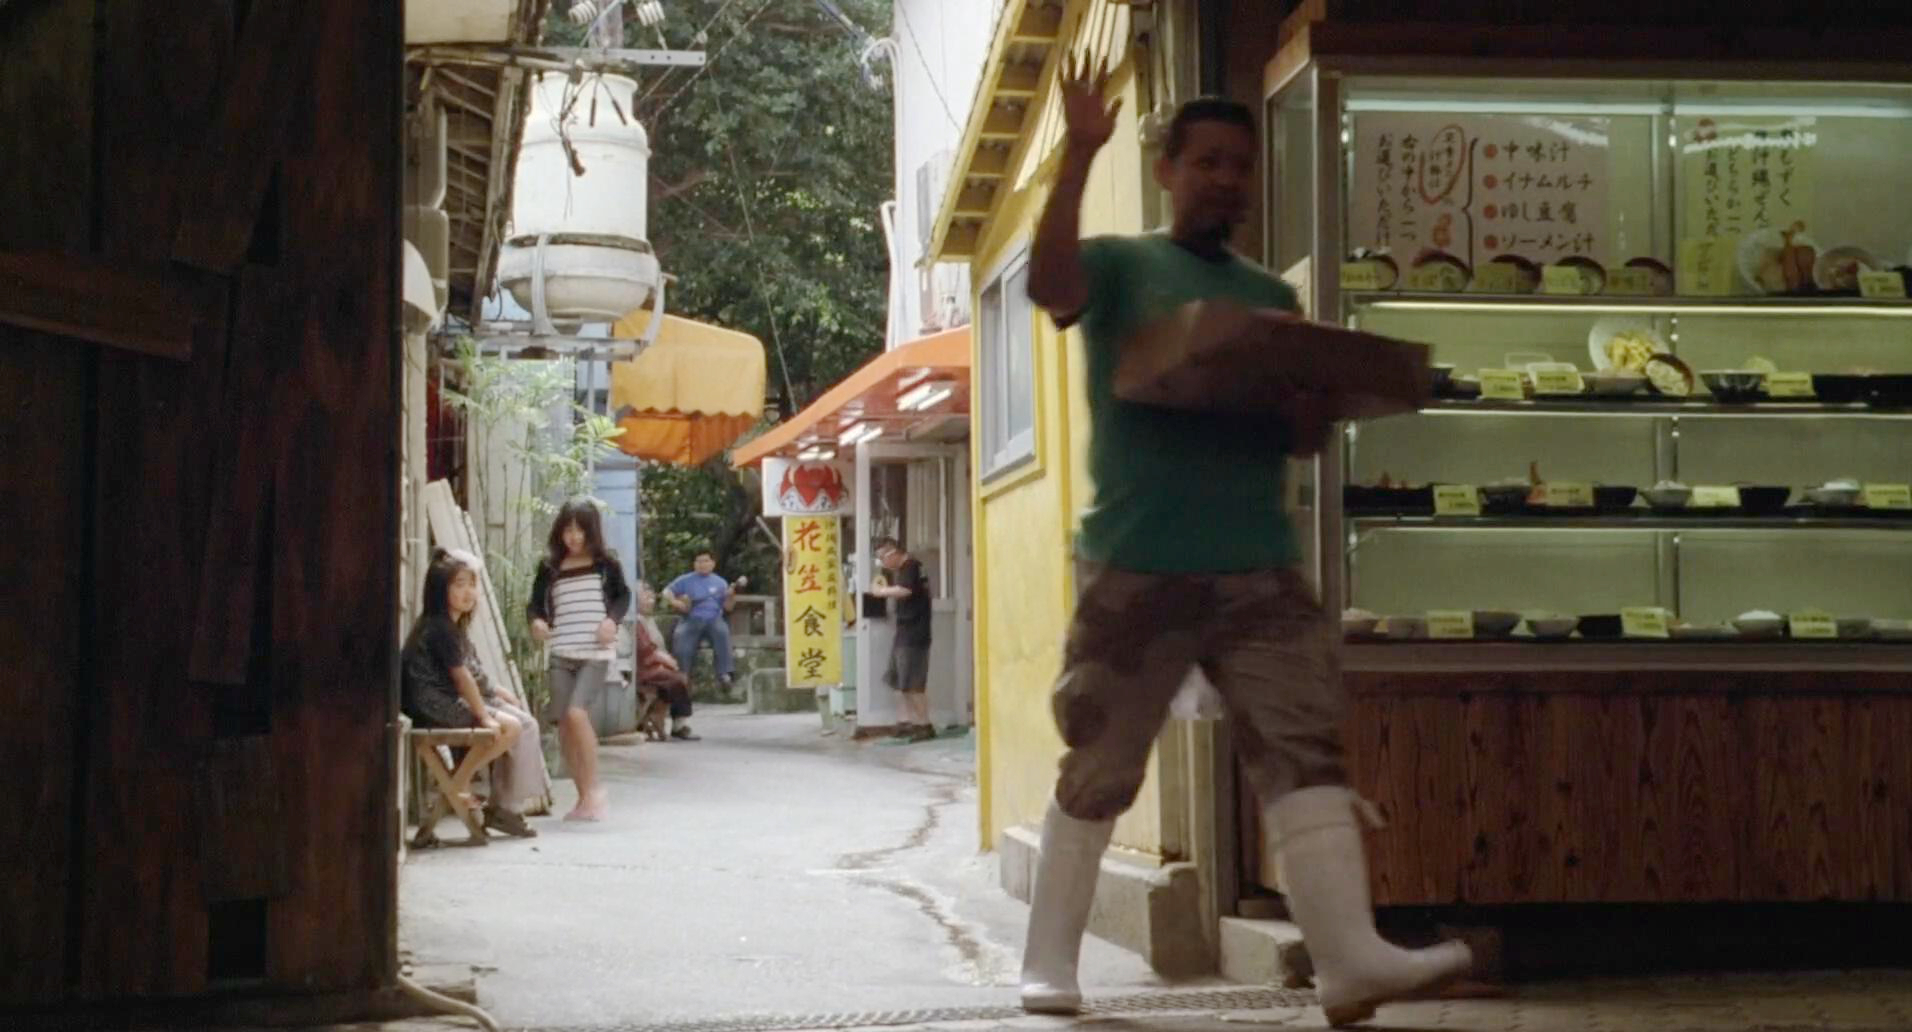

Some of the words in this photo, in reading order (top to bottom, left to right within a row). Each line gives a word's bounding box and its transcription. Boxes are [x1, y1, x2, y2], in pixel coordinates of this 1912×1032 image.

[1502, 139, 1571, 162] 中味汁
[1503, 171, 1593, 191] イナムルチ
[1501, 201, 1577, 225] ゆし豆腐
[1502, 232, 1595, 253] ソーメン汁
[793, 520, 828, 680] 花笠食堂
